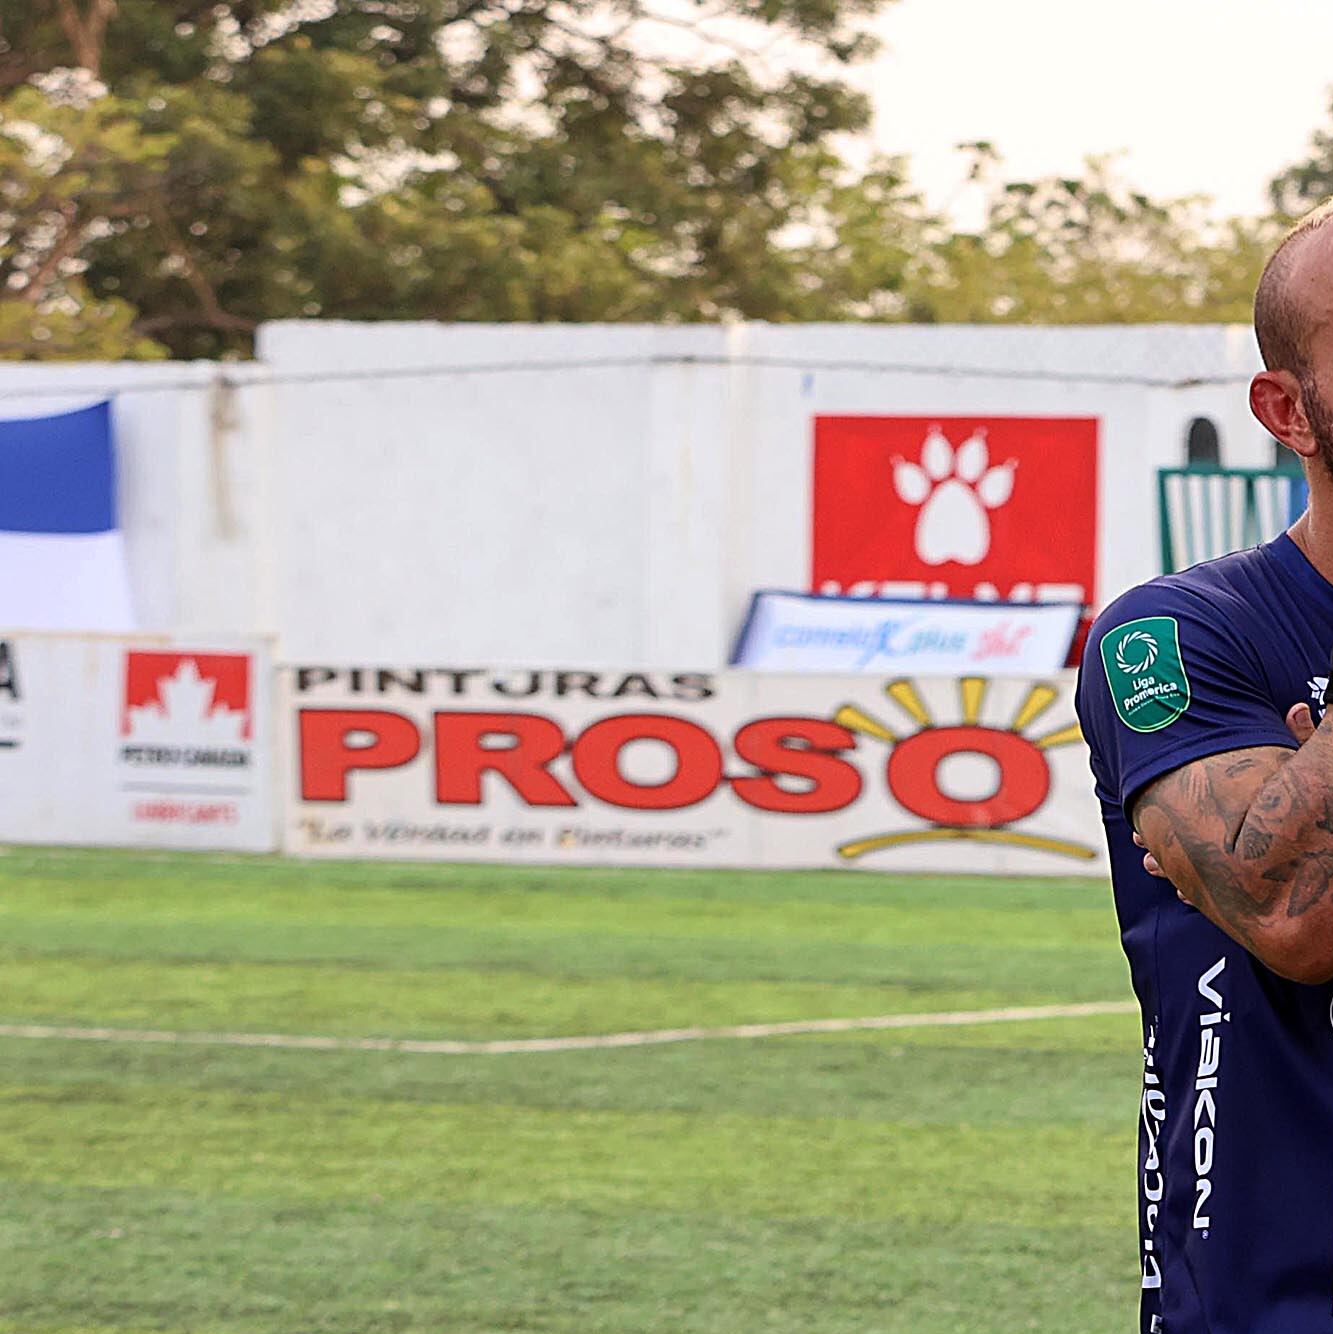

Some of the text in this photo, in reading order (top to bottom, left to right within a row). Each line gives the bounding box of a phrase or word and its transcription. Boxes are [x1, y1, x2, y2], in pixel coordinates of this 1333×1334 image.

[1123, 682, 1178, 710] Promerica
[1133, 676, 1155, 691] Liga
[297, 708, 1050, 829] PROSO
